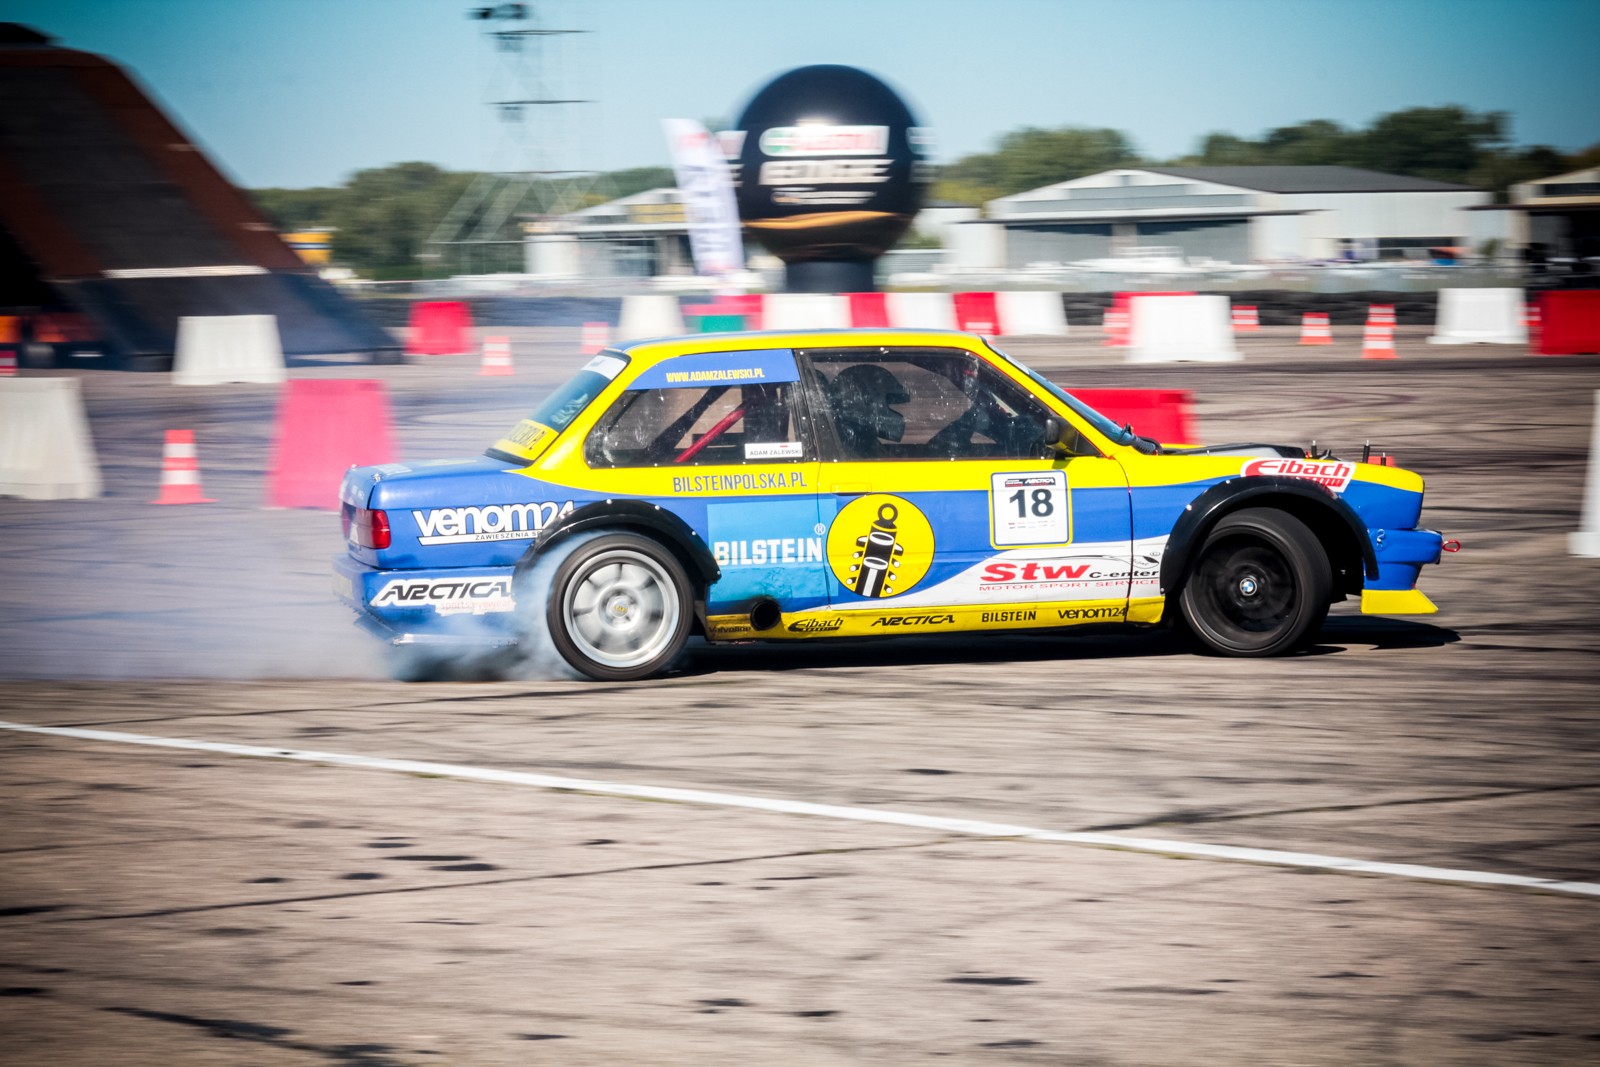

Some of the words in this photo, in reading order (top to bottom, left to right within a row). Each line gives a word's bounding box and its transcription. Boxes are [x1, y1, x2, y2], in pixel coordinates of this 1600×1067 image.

[666, 368, 765, 383] WWW.ADAMZALEWSKI.PL
[1245, 459, 1351, 477] Eibach
[673, 472, 807, 492] BILSTEINPOLSKA.PL
[1009, 488, 1054, 518] 18
[412, 500, 575, 537] venom24
[475, 533, 529, 541] ZAWIESZENIA
[713, 537, 822, 566] BILSTEIN
[1096, 579, 1159, 587] SERVICE
[380, 582, 513, 601] ARCTICA
[871, 614, 955, 627] ARCTICA
[982, 611, 1037, 623] BILSTEIN
[1058, 607, 1128, 619] venom24
[788, 617, 844, 632] Eibach
